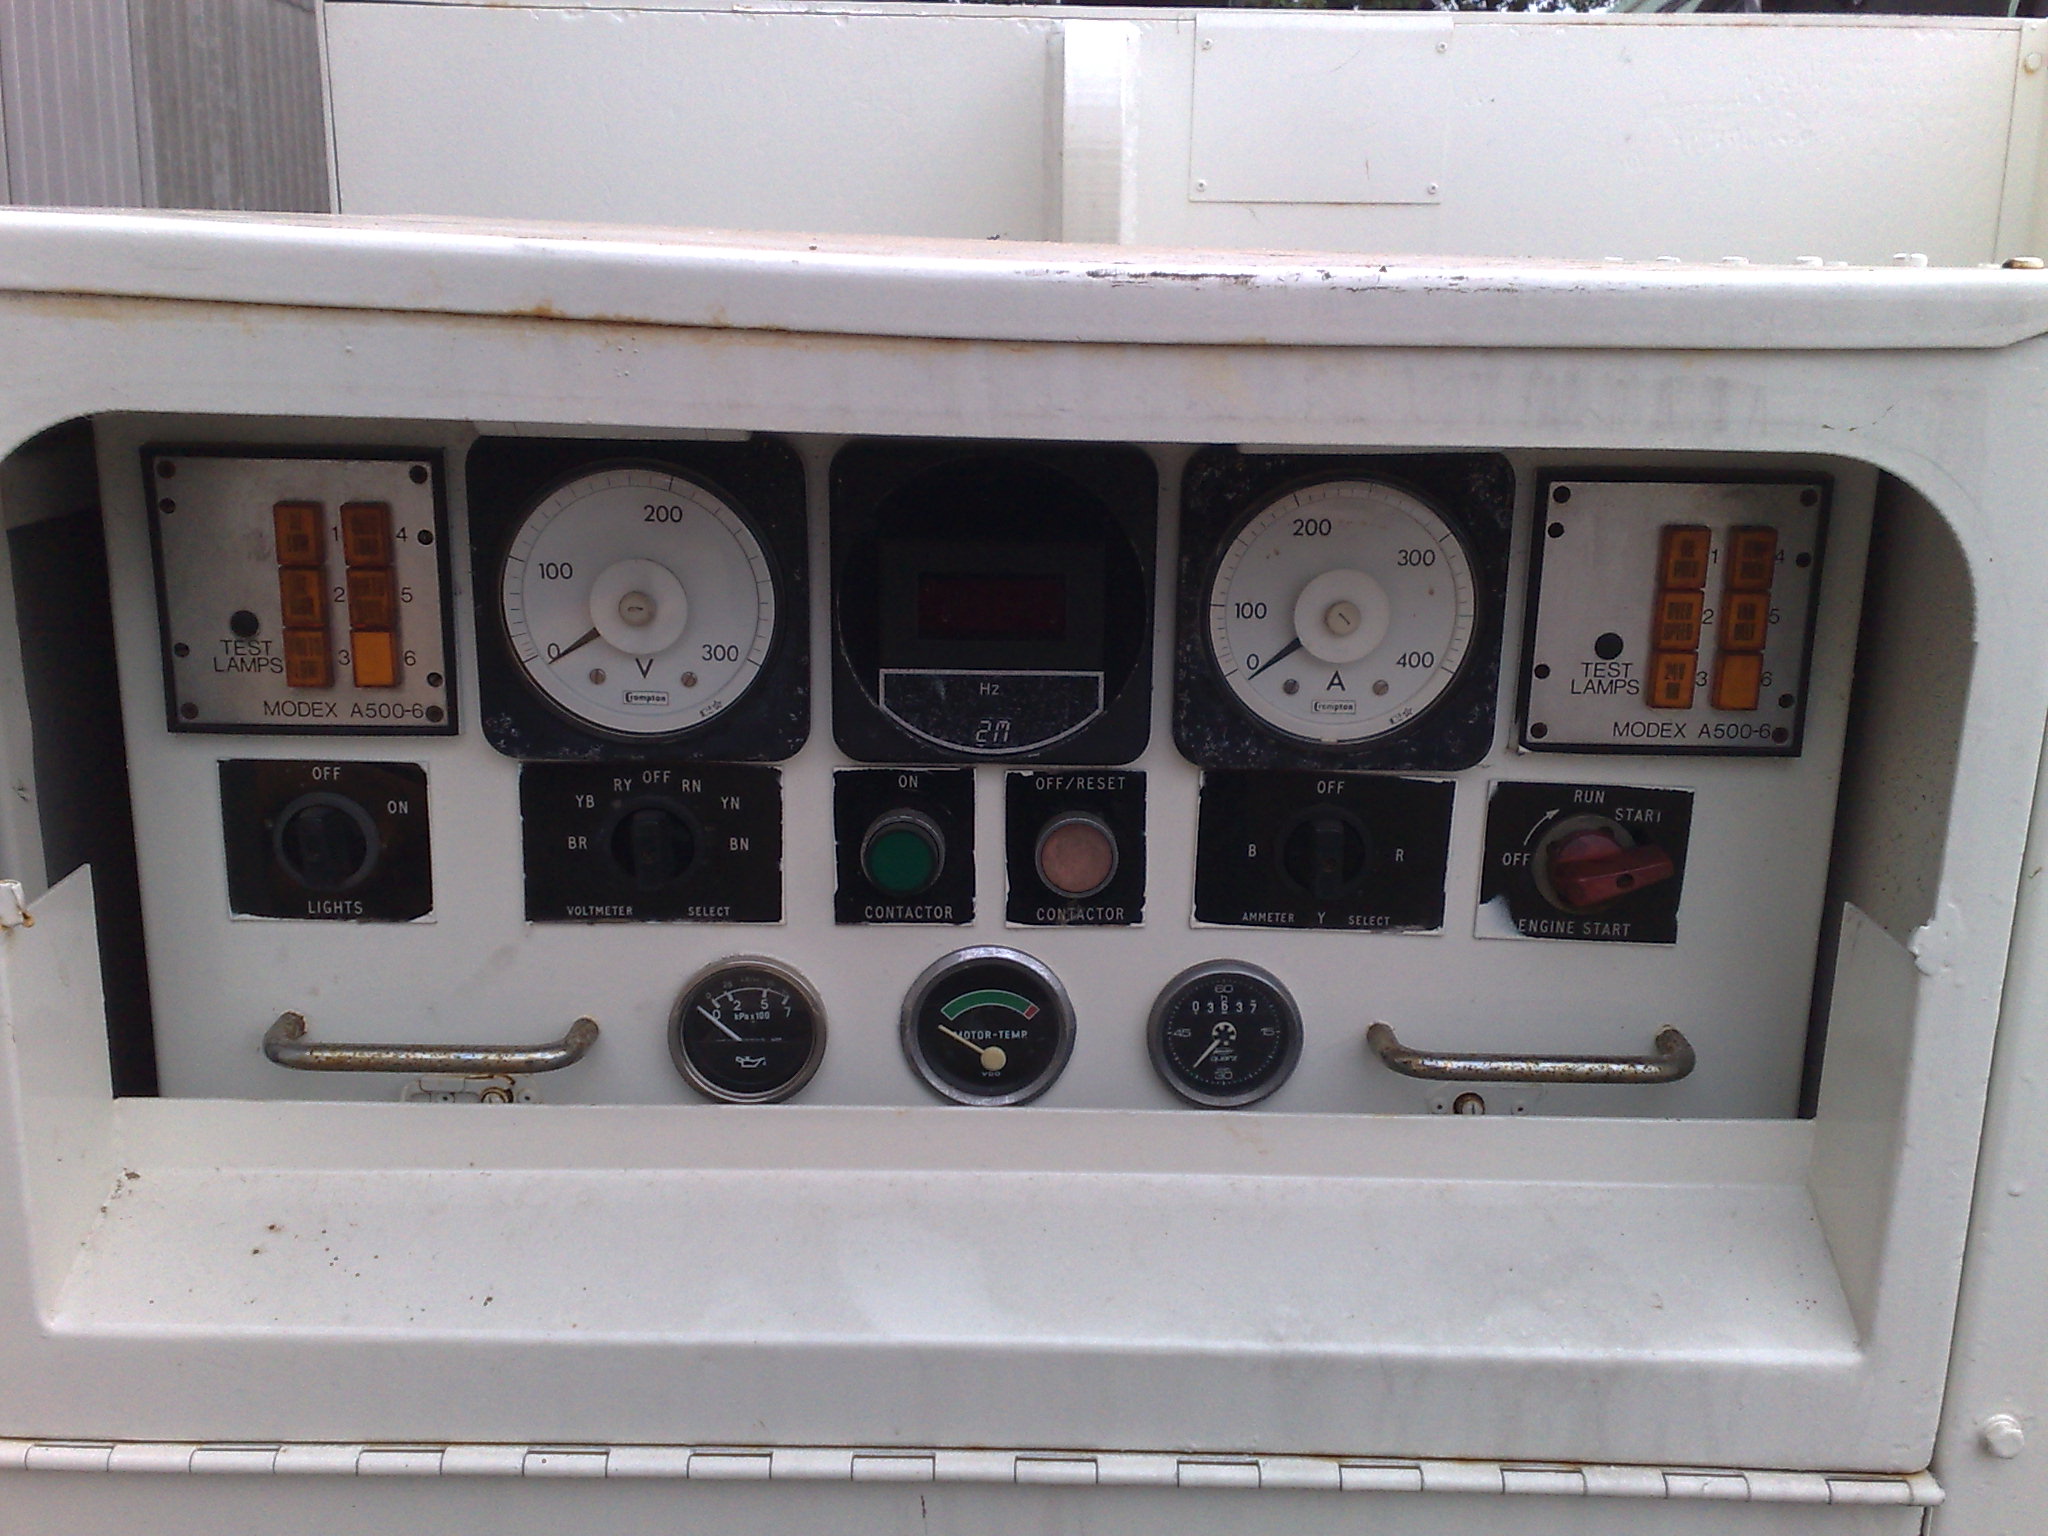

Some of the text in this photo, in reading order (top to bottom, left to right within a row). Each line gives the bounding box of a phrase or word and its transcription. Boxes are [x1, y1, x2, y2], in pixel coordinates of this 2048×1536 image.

[644, 505, 683, 523] 200
[331, 526, 340, 541] 1
[396, 527, 409, 541] 4
[1293, 518, 1332, 536] 200
[1397, 549, 1436, 567] 300
[1710, 549, 1719, 564] 1
[1775, 549, 1786, 564] 4
[538, 562, 574, 580] 100
[333, 587, 346, 602] 2
[401, 587, 413, 603] 5
[1235, 602, 1268, 620] 100
[1702, 609, 1714, 625] 2
[1768, 609, 1781, 625] 5
[220, 640, 273, 656] TEST
[547, 643, 561, 661] 0
[701, 644, 740, 662] 300
[213, 657, 284, 674] LAMPS
[338, 650, 351, 666] 3
[404, 650, 417, 666] 6
[1246, 653, 1260, 670] 0
[1396, 651, 1435, 669] 400
[635, 658, 654, 679] V
[1581, 662, 1633, 678] TEST
[1326, 670, 1346, 691] A
[1695, 671, 1708, 687] 3
[1760, 671, 1773, 687] 6
[1570, 679, 1640, 696] LAMPS
[625, 692, 667, 703] Crompton
[263, 700, 424, 719] MODEX A500-6
[1612, 721, 1771, 739] MODEX A500-6
[312, 766, 341, 781] OFF
[642, 770, 671, 784] OFF
[614, 778, 632, 792] RY
[682, 779, 701, 793] RN
[898, 775, 919, 789] ON
[1035, 776, 1126, 790] OFF/RESET
[1317, 780, 1345, 794] OFF
[576, 795, 595, 809] YB
[721, 796, 740, 810] YN
[1574, 789, 1606, 804] RUN
[387, 800, 409, 814] ON
[568, 836, 588, 850] BR
[729, 837, 749, 851] BN
[1248, 843, 1257, 857] B
[1395, 848, 1404, 862] R
[1502, 852, 1531, 866] OFF
[307, 900, 363, 915] LIGHTS
[566, 905, 730, 917] VOLTMETER SELECT
[864, 905, 954, 920] CONTACTOR
[1036, 906, 1125, 922] CONTACTOR
[1242, 912, 1390, 926] AMMETER SELECT
[1317, 911, 1326, 924] Y
[1518, 918, 1631, 937] ENGINE START
[733, 1001, 742, 1011] 2
[761, 1000, 769, 1010] 5
[784, 1007, 791, 1018] 7
